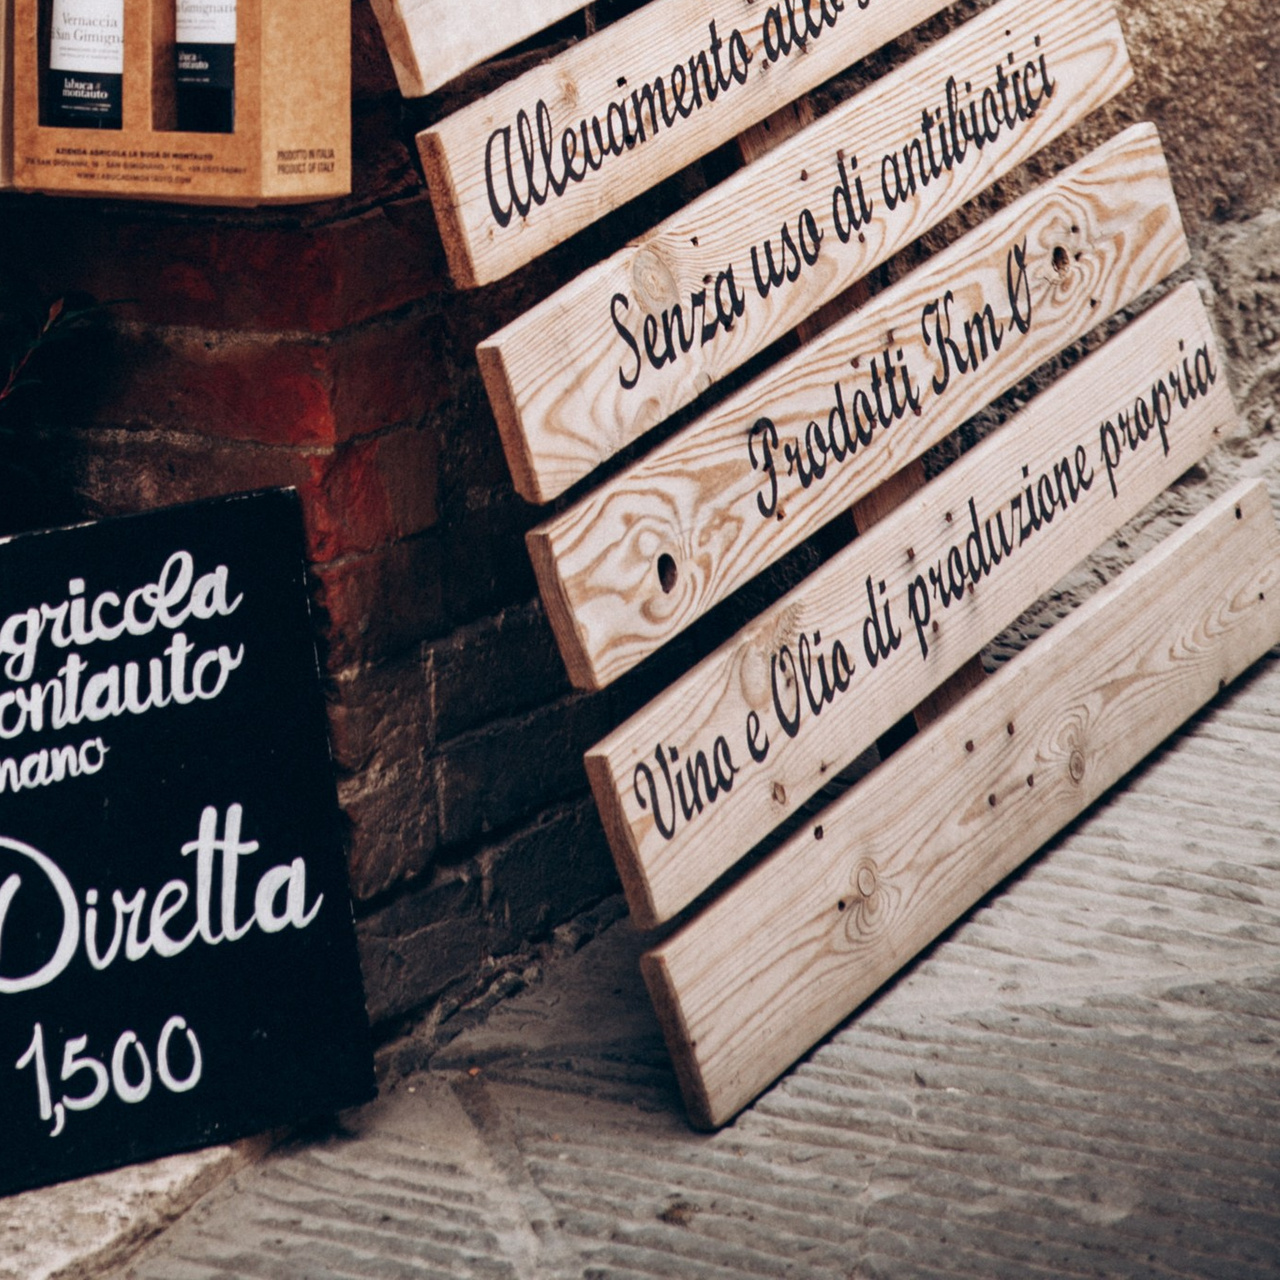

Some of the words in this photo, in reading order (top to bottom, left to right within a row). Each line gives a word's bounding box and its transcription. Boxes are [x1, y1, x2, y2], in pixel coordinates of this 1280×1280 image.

[482, 10, 752, 231] Allevamento
[608, 251, 746, 392] Senza
[749, 207, 826, 302] uso
[829, 149, 871, 241] di
[879, 36, 1057, 209] antibiotici
[745, 346, 922, 521] Prodotti
[922, 288, 1007, 396] Km
[633, 722, 738, 841] Vino
[743, 709, 770, 763] e
[770, 628, 856, 740] Olio
[861, 572, 905, 669] di
[904, 441, 1096, 662] produzione
[1096, 339, 1220, 501] propria
[16, 1014, 204, 1139] 1,500
